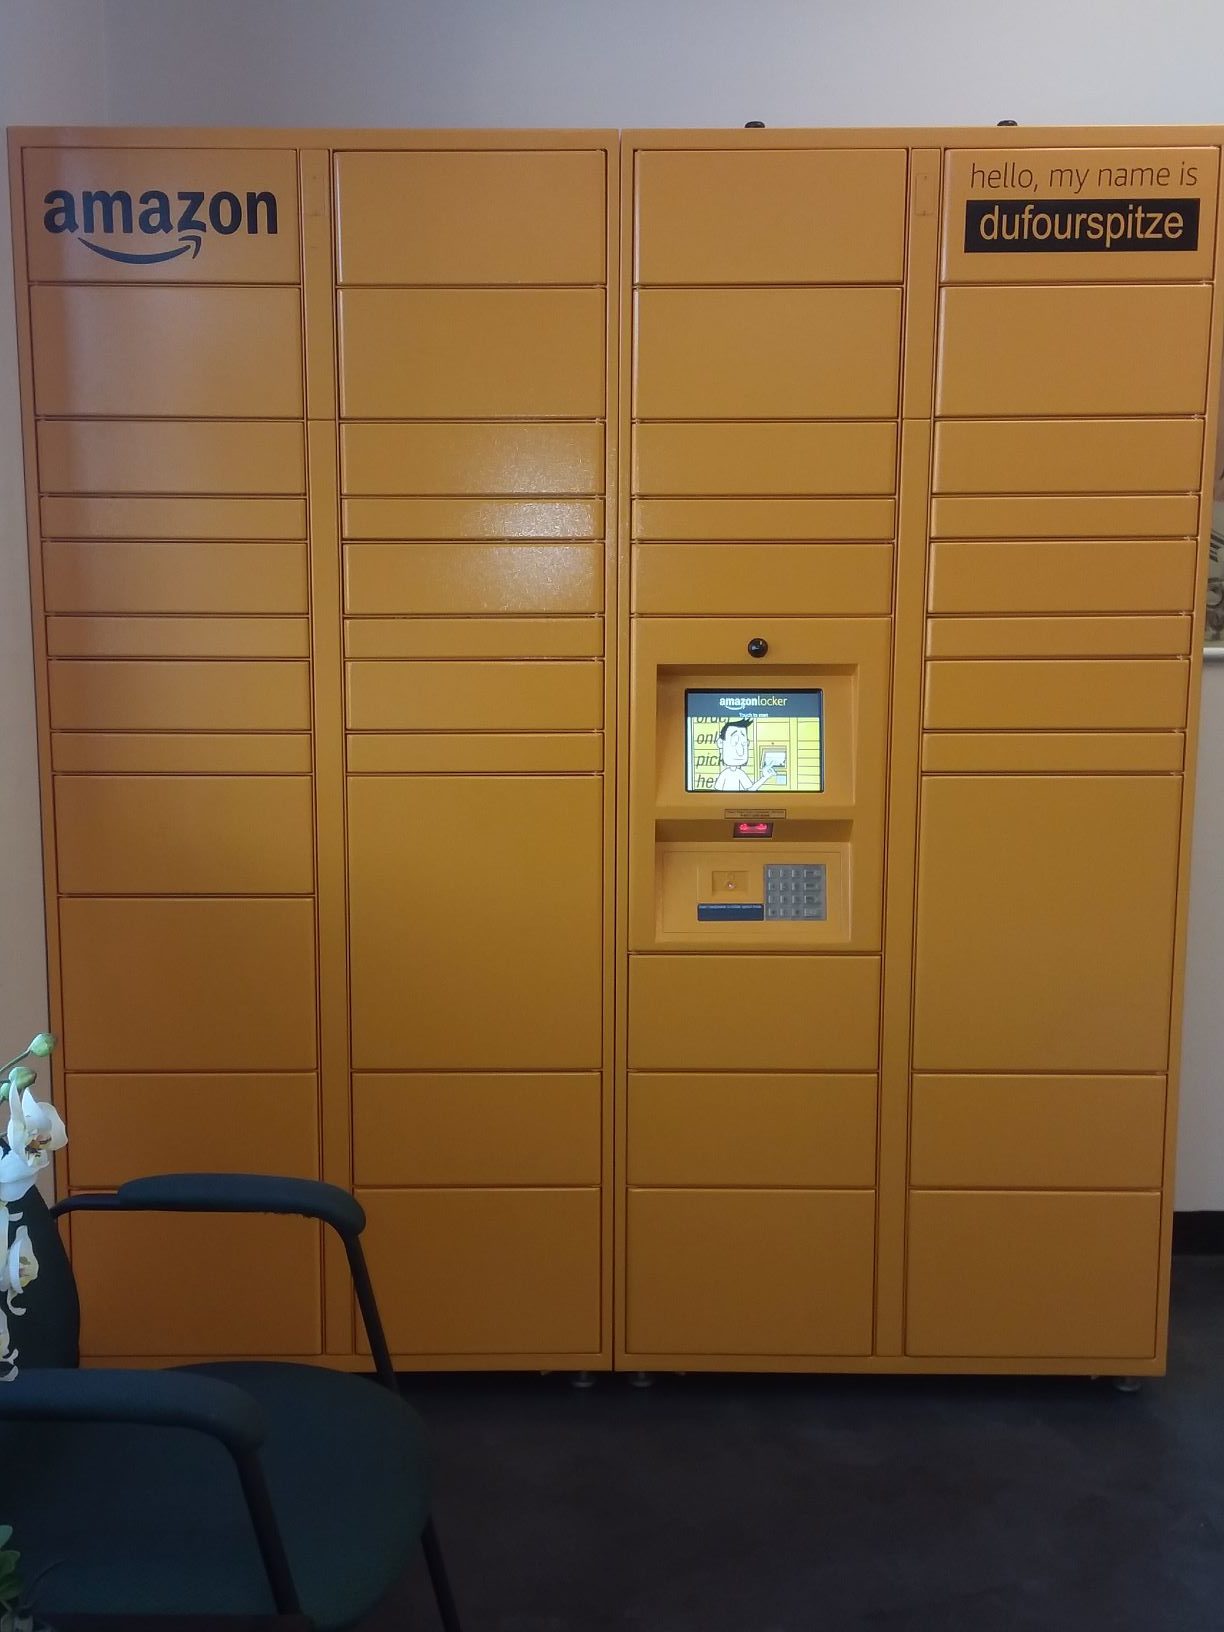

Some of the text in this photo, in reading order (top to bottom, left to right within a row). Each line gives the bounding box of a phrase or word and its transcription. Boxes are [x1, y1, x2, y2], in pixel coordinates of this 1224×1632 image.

[970, 161, 1198, 194] hello, my name is
[43, 189, 278, 235] amazon
[979, 203, 1184, 249] dufourspitze
